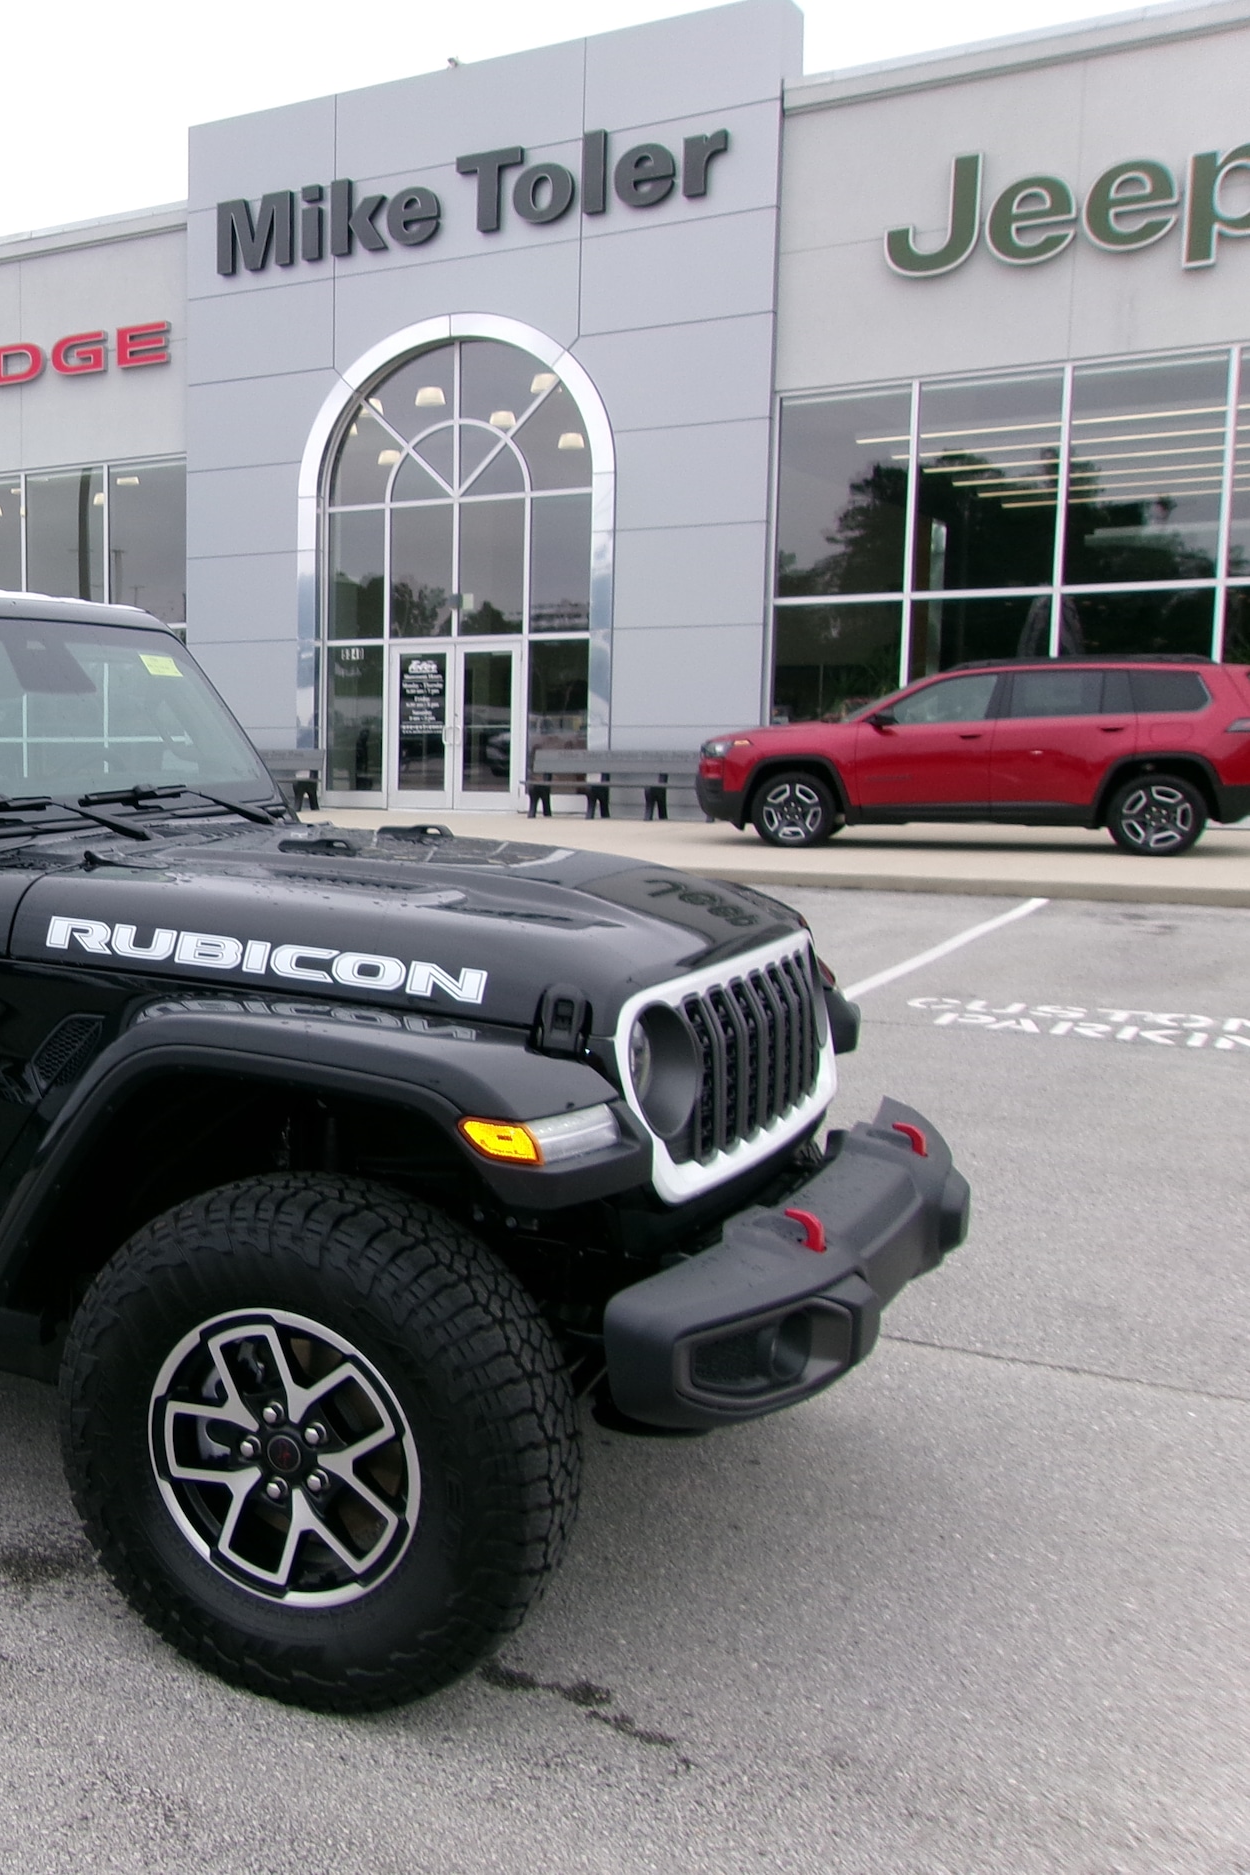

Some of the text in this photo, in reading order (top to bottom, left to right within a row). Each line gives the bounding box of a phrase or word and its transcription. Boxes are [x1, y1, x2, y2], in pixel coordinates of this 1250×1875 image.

[216, 128, 729, 276] Mike Toler
[883, 142, 1250, 277] Jeep
[46, 915, 488, 1004] RUBICON
